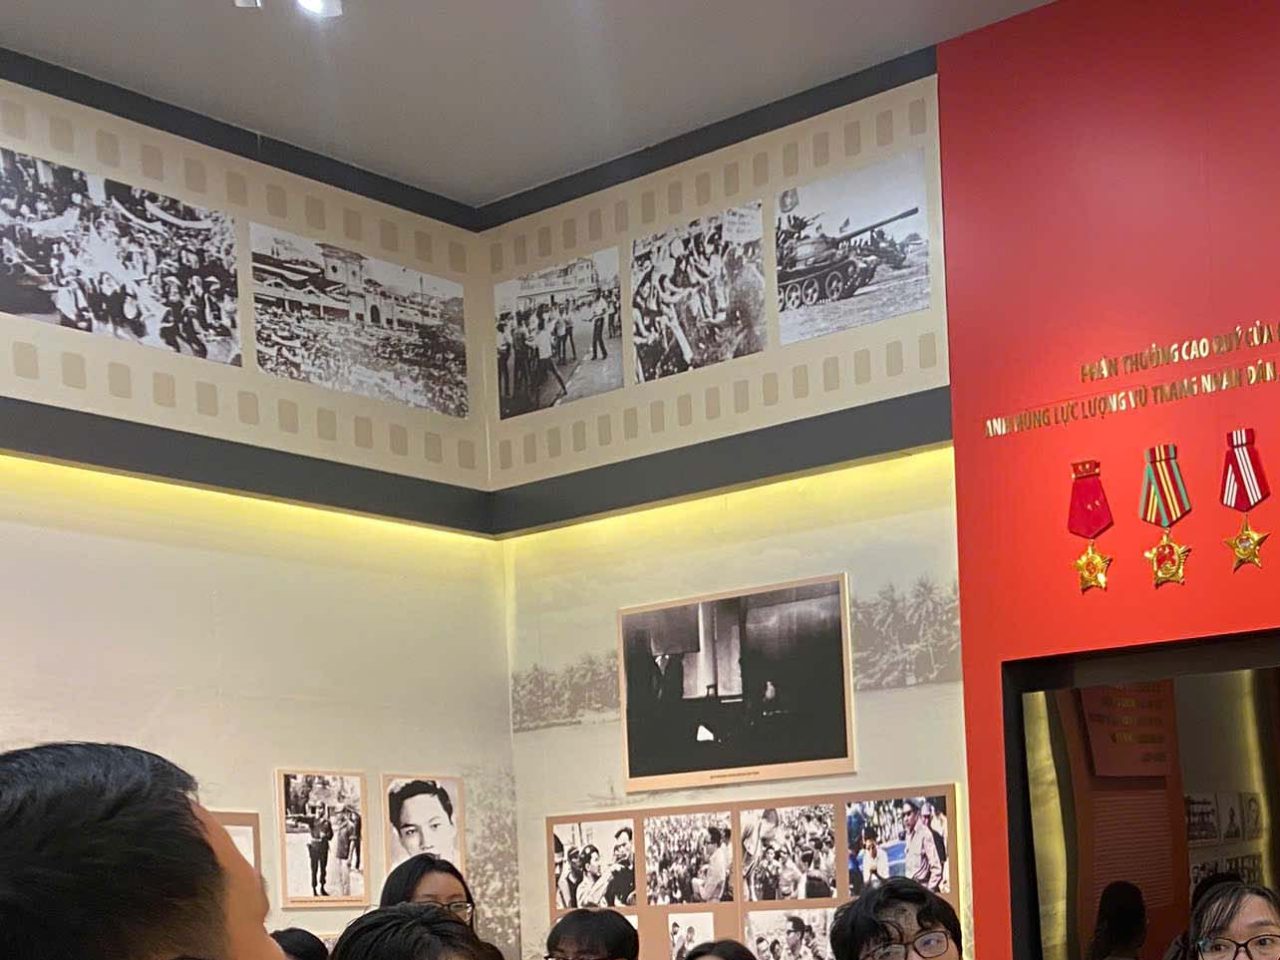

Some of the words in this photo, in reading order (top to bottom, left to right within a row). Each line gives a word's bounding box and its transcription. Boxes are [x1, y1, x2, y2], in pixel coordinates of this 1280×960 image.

[1181, 337, 1210, 361] CAO
[1212, 326, 1243, 354] QUÝ
[1246, 319, 1273, 348] CỦA
[985, 417, 1013, 438] ANH
[1054, 400, 1079, 427] LỰC
[1151, 376, 1198, 405] TRANG
